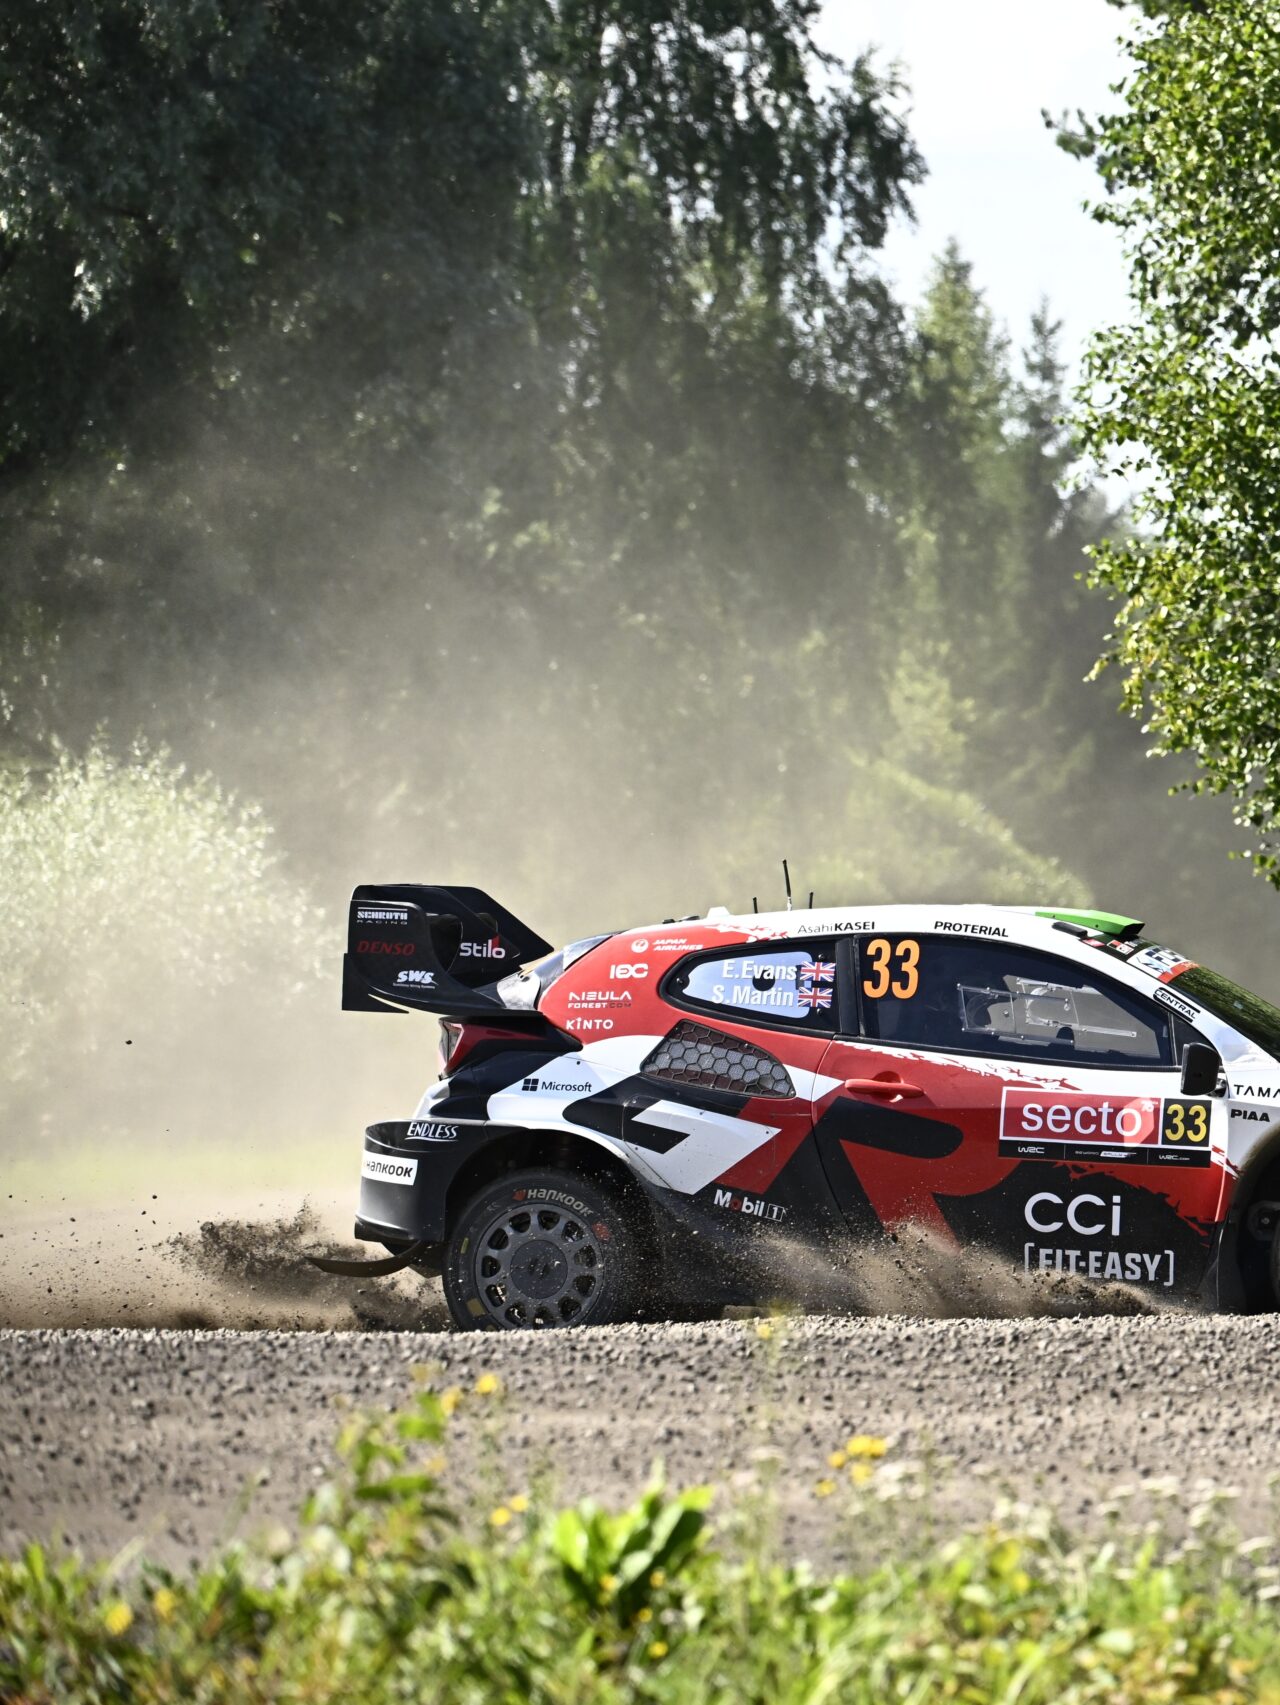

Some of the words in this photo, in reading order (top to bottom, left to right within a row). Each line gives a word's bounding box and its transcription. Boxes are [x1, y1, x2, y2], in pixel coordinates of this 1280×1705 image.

[357, 910, 408, 920] SCHROTH
[933, 920, 1009, 938] PROTERIAL
[357, 940, 415, 956] DENSO
[460, 938, 506, 959] Stilo
[397, 970, 435, 984] SWS
[722, 959, 798, 981] E.Evans
[863, 938, 920, 999] 33
[711, 984, 794, 1007] S.Martin
[1154, 989, 1196, 1019] CENTRAL
[541, 1080, 593, 1093] Microsoft
[1021, 1101, 1142, 1137] secto
[1164, 1104, 1208, 1143] 33
[1230, 1108, 1270, 1122] PIAA
[407, 1122, 459, 1140] ENDLESS
[1017, 1145, 1045, 1154] WRC
[713, 1188, 766, 1217] Mobil
[1024, 1191, 1121, 1237] CCi
